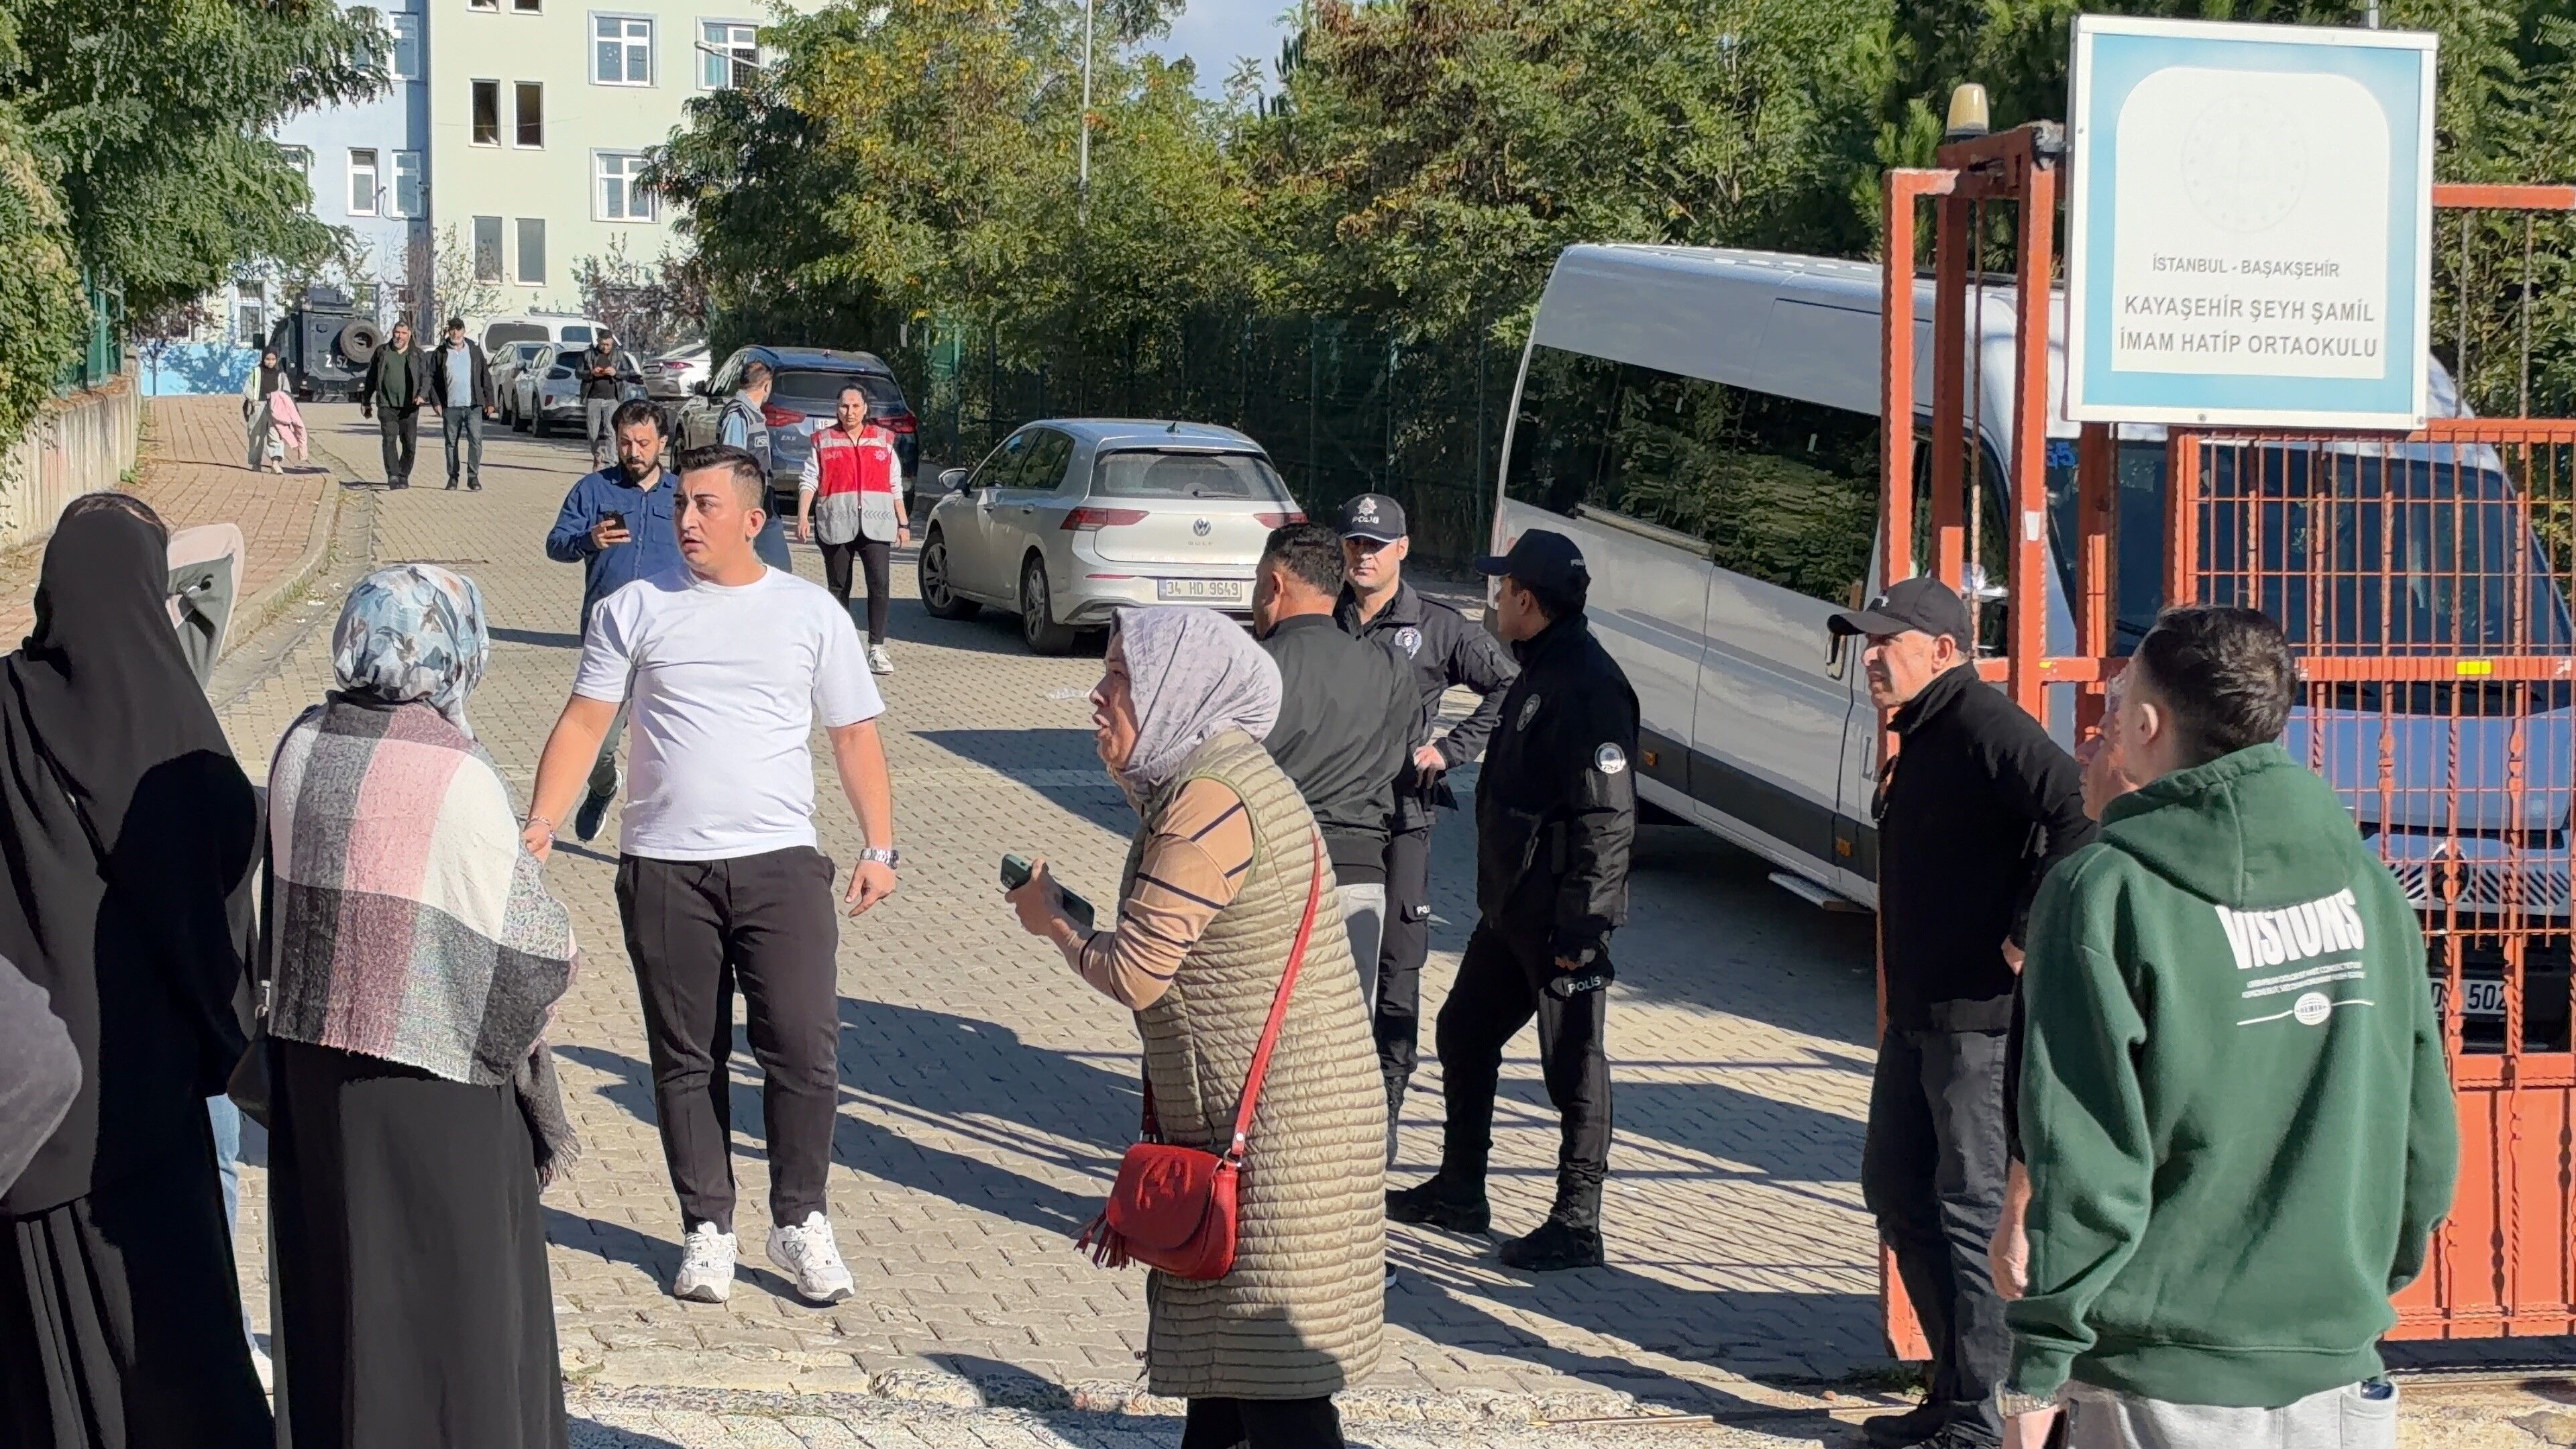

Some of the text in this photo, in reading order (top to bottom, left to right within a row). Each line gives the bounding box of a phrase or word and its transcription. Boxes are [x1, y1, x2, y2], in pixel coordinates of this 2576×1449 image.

[2152, 253, 2228, 274] İSTANBUL
[2241, 260, 2340, 280] BAŞAKŞEHİR
[2125, 294, 2374, 325] KAYAŞEHİR ŞEYH ŞAMİL
[2120, 326, 2377, 358] İMAM HATİP ORTAOKULU
[1167, 582, 1239, 596] 34 HD 9649
